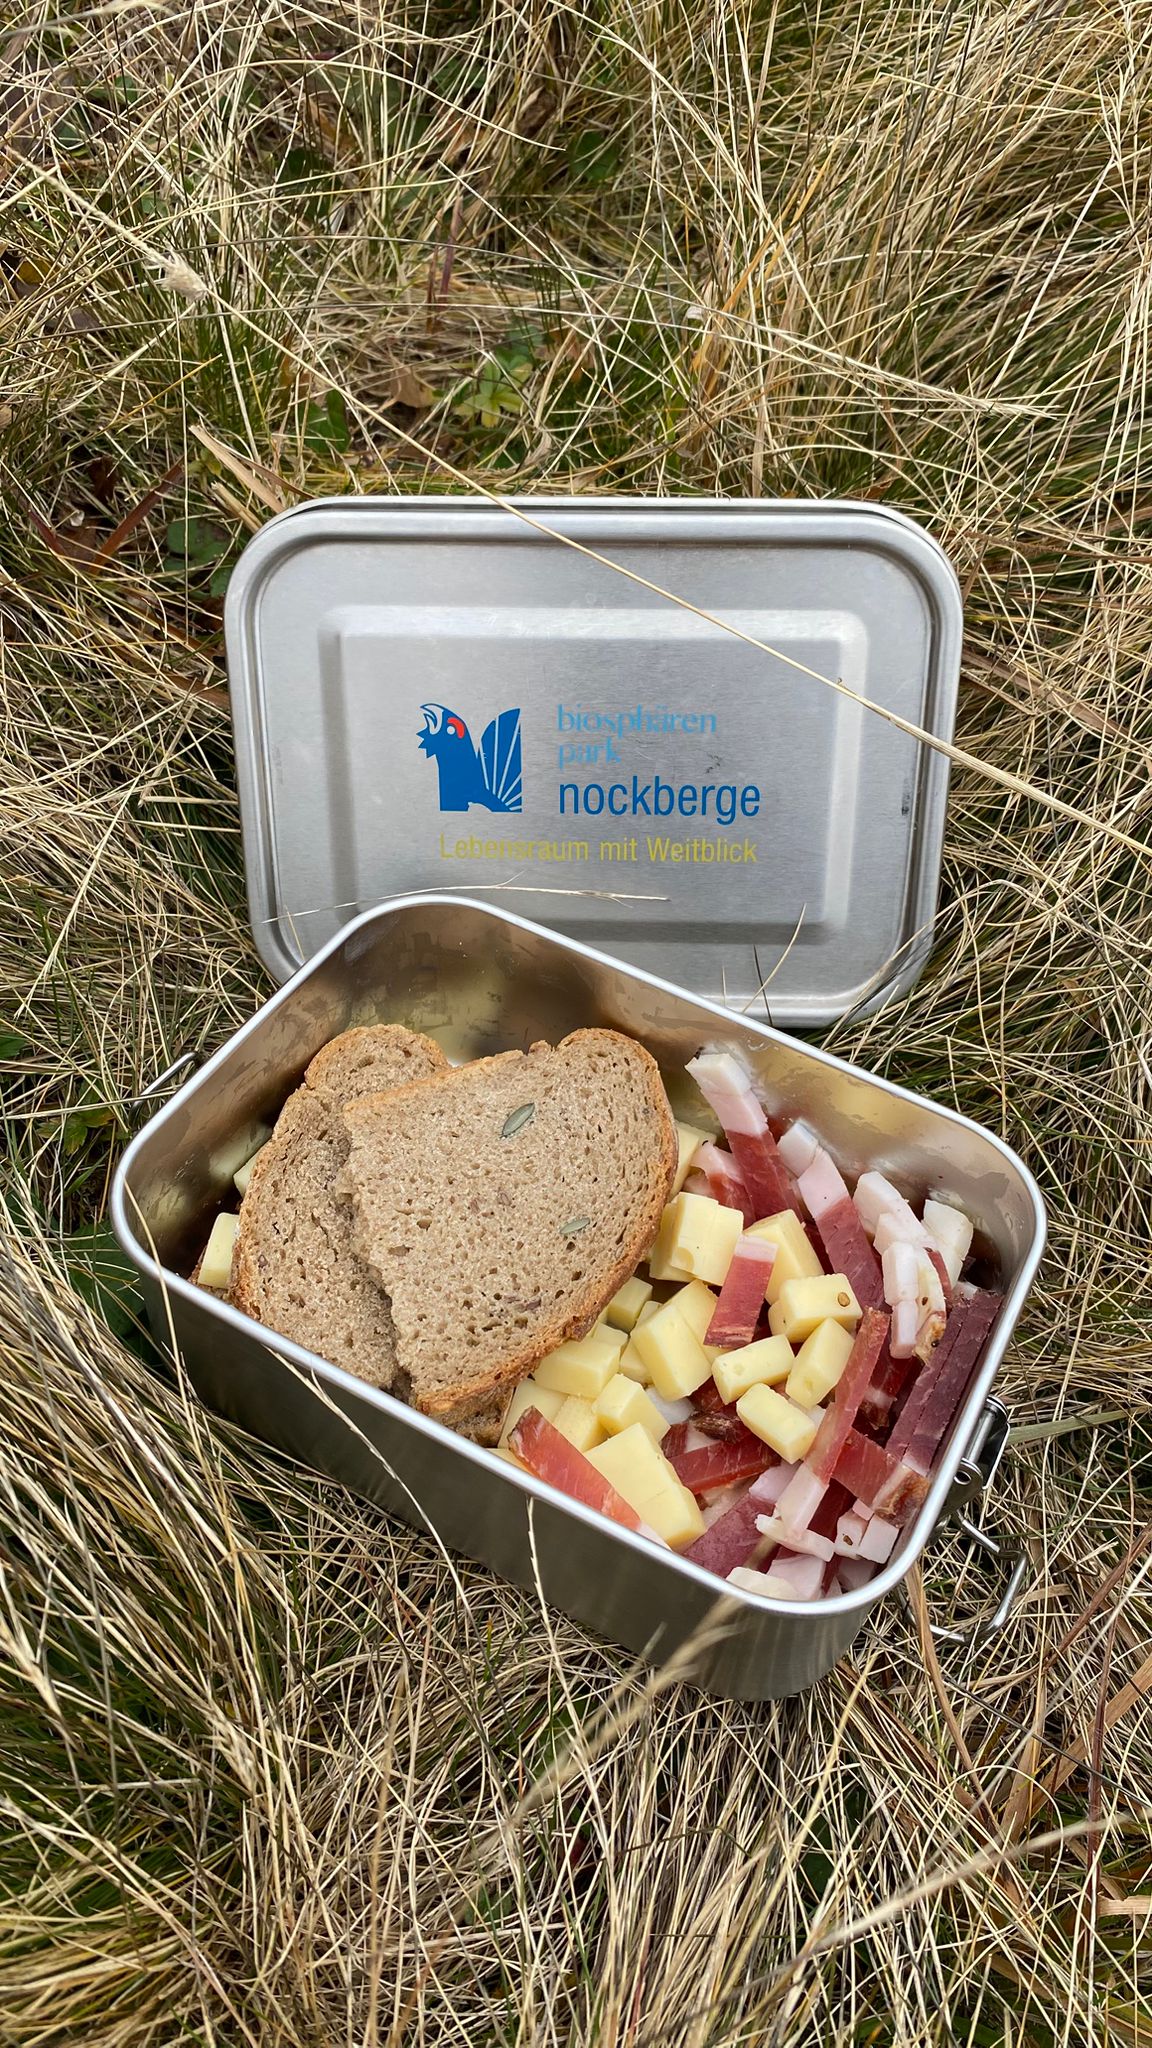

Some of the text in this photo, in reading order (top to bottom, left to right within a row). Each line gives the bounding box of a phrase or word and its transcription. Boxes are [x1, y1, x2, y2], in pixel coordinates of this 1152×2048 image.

[556, 703, 717, 738] biosphären
[557, 737, 622, 769] park
[559, 775, 760, 826] nockberge
[439, 832, 758, 863] Lebensraum mit Weitblick
